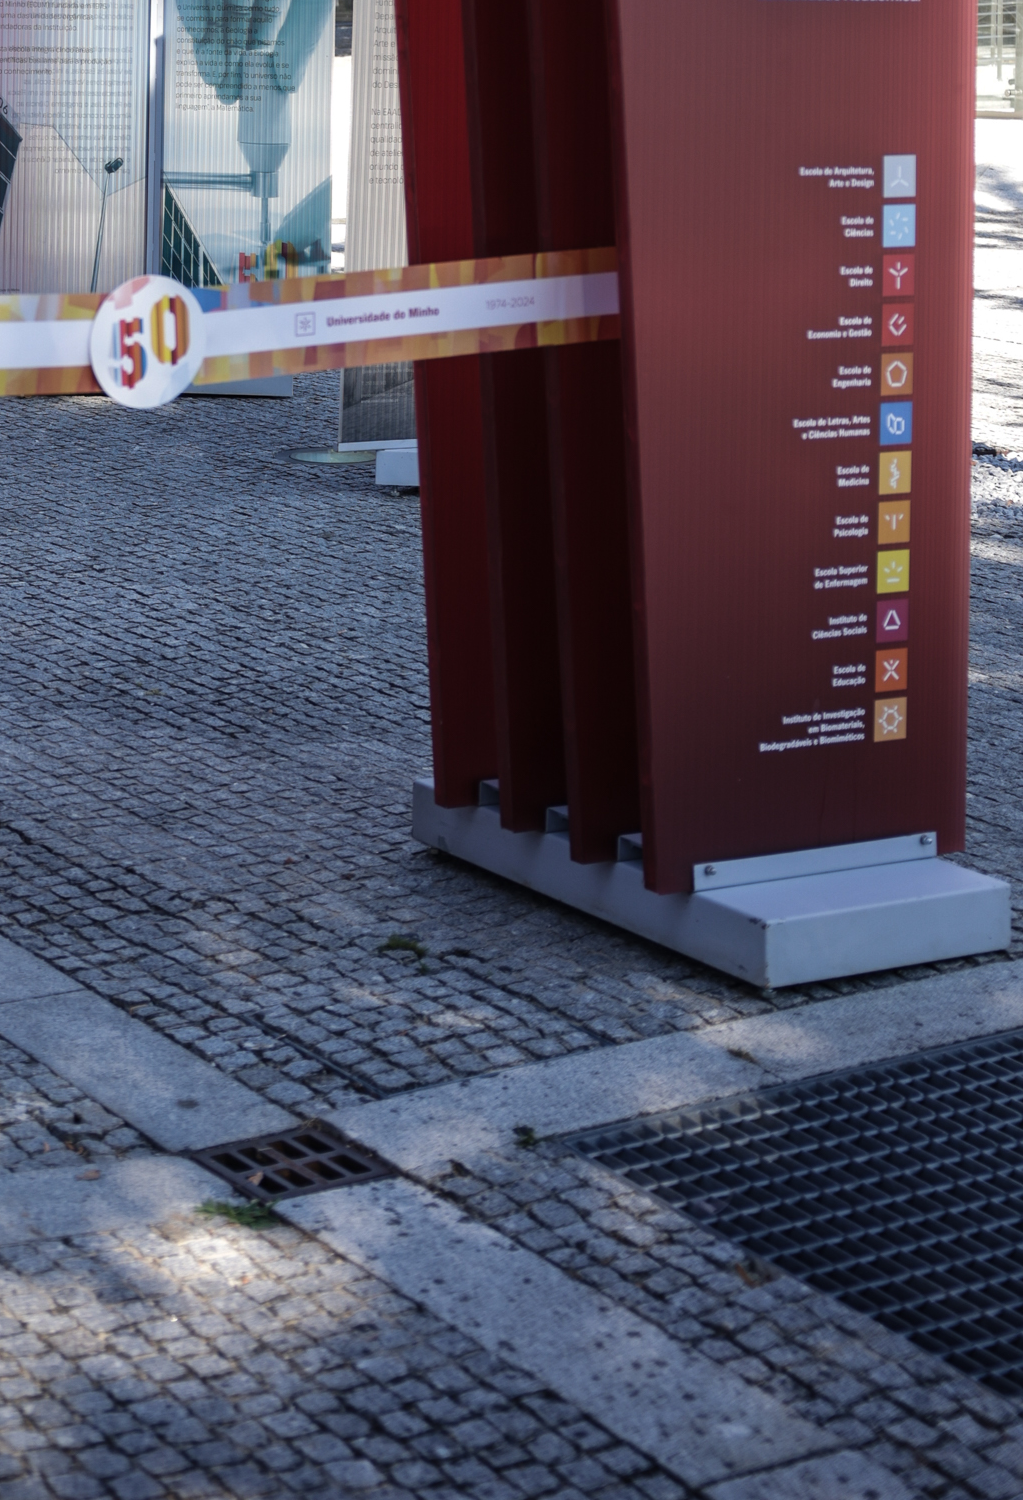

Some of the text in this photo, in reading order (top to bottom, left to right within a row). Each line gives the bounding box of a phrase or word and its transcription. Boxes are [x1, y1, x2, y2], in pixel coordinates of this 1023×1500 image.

[485, 296, 535, 311] 1974-2024
[326, 307, 440, 327] Universidade do Minho
[114, 295, 191, 389] 50
